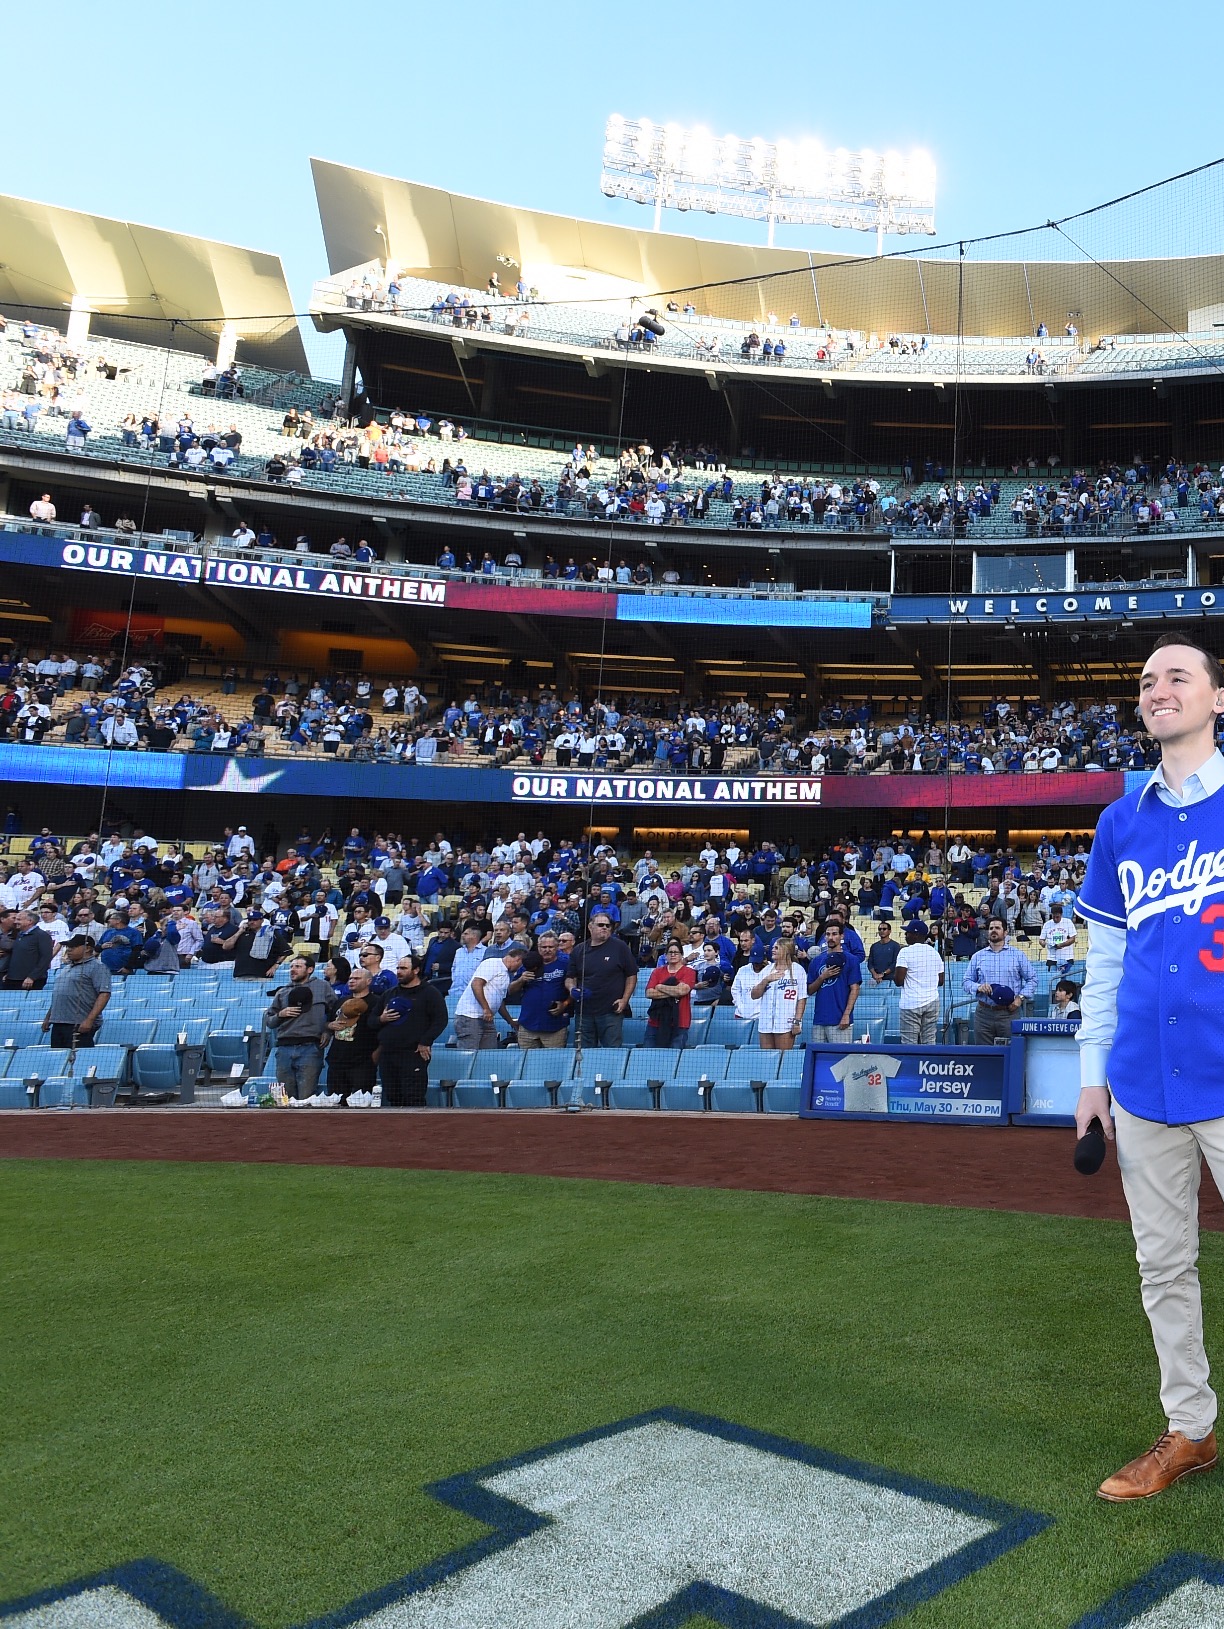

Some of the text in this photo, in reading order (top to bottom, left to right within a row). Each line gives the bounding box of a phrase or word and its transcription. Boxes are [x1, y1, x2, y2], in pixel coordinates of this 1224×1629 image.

[62, 544, 446, 602] OUR NATIONAL ANTHEM
[948, 596, 1138, 614] WELCOME
[1174, 592, 1216, 608] TO
[512, 776, 822, 801] OUR NATIONAL ANTHEM
[668, 832, 697, 840] DECK
[700, 833, 736, 841] CIRCLE
[784, 989, 797, 1000] 22
[1021, 1023, 1038, 1032] JUNE
[1047, 1023, 1068, 1032] STEVE
[918, 1060, 974, 1076] Koufax
[867, 1073, 882, 1086] 32
[919, 1078, 971, 1098] Jersey
[890, 1102, 1000, 1116] Thu, May 30 7:10 PM
[1033, 1099, 1054, 1109] ANC
